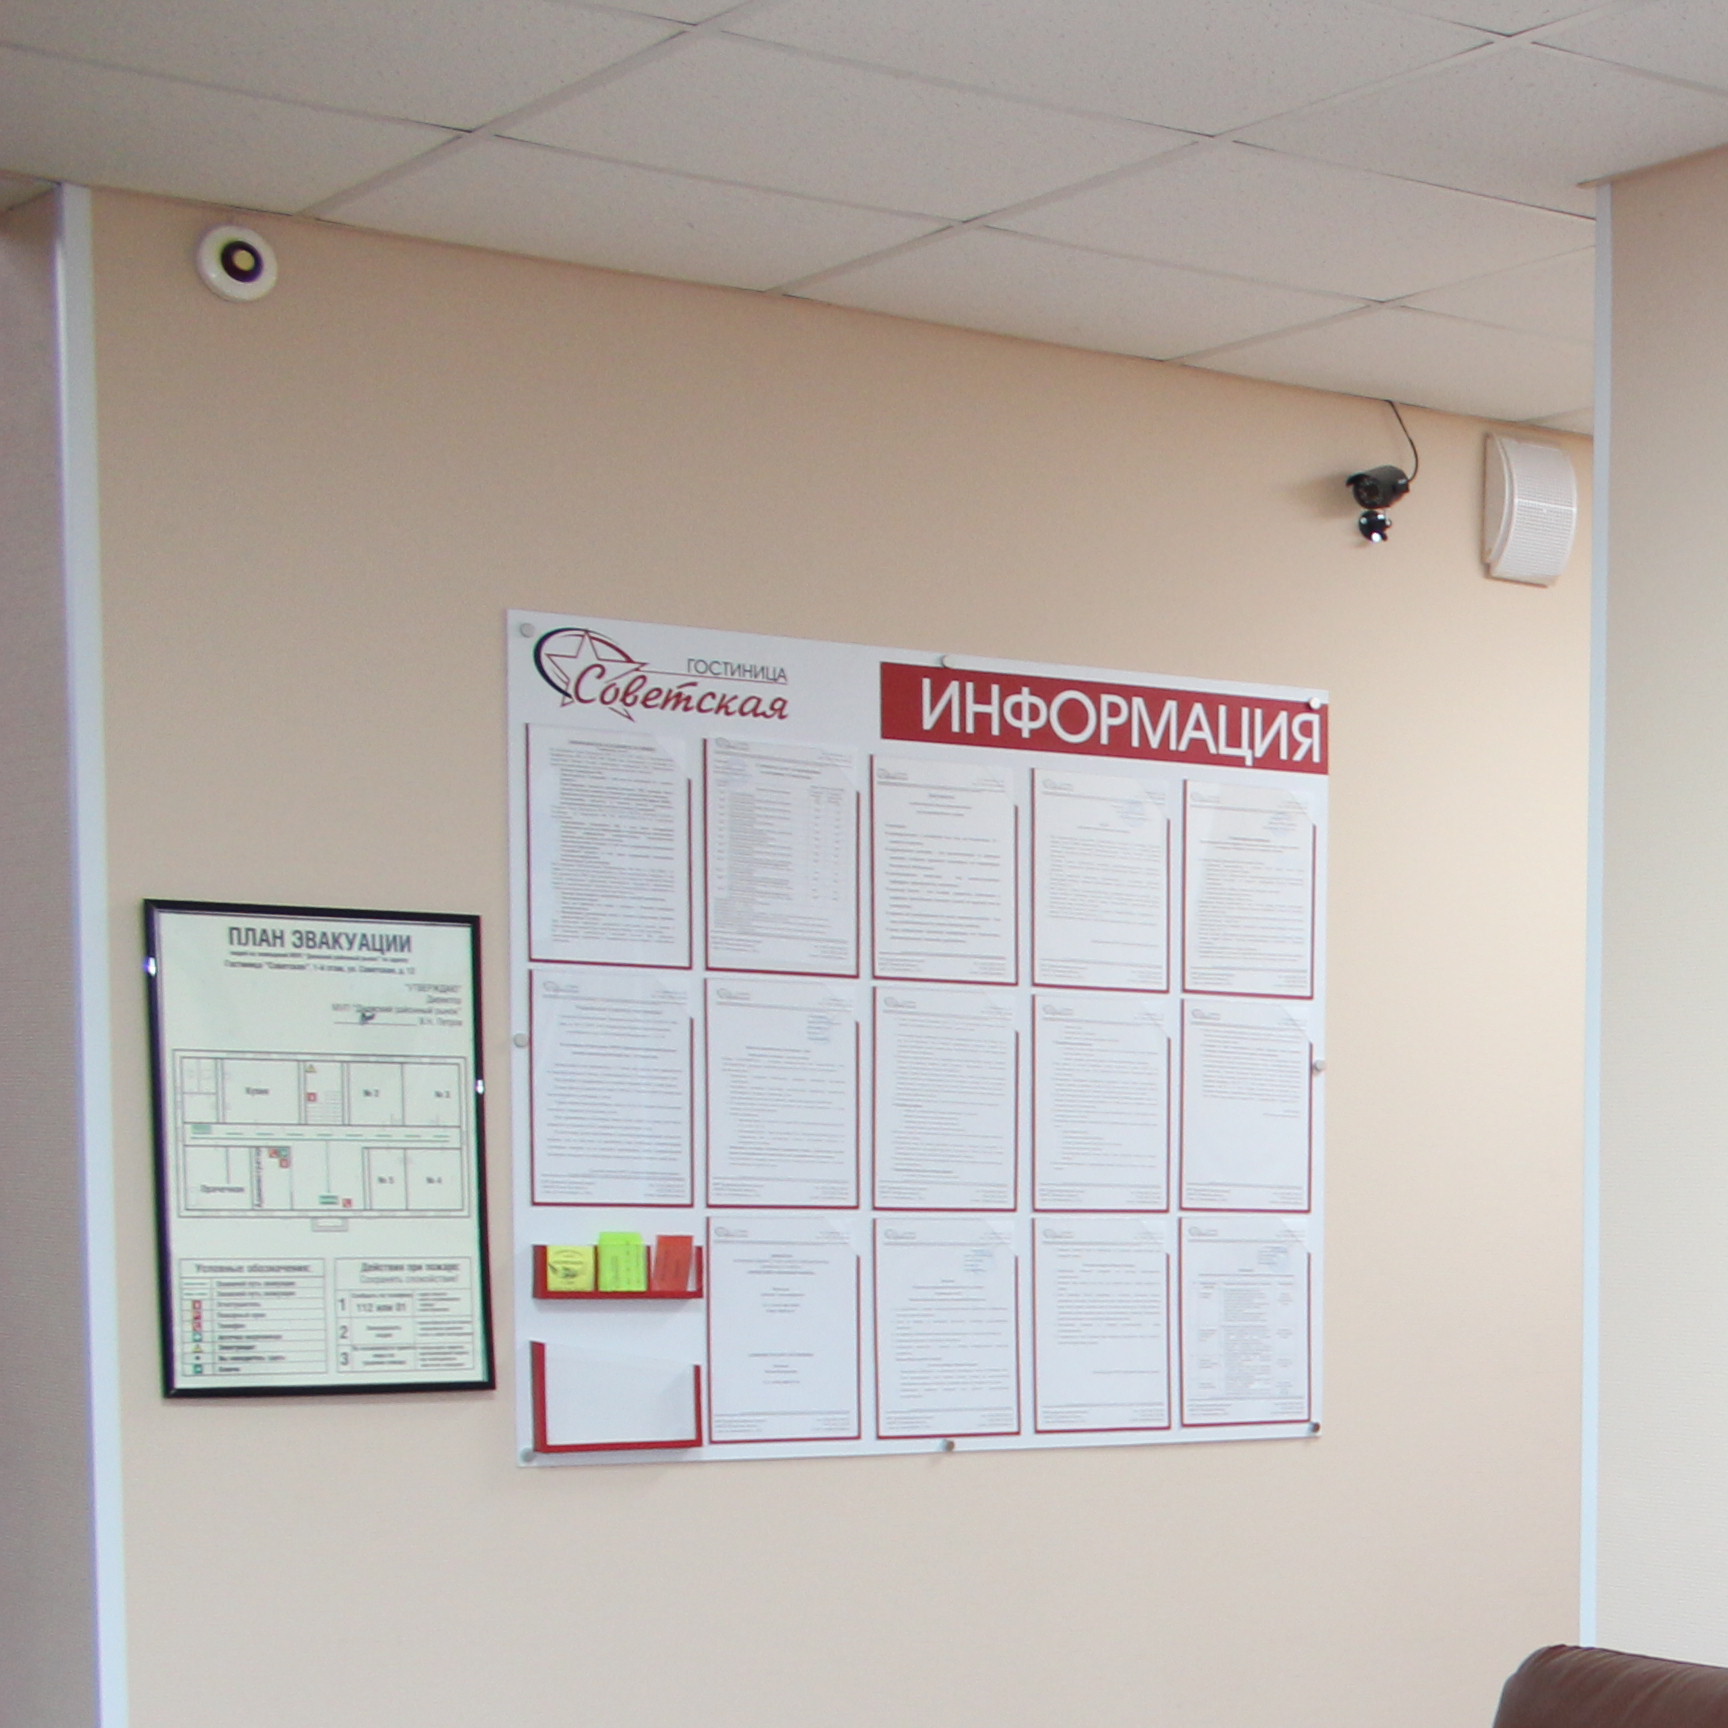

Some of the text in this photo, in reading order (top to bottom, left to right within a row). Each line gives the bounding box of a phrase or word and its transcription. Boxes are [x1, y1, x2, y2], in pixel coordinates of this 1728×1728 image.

[573, 662, 790, 720] Советская
[687, 658, 788, 682] ГОСТИНИЦА
[920, 676, 1322, 767] ИНФОРМАЦИЯ
[228, 926, 413, 955] ПЛАН ЭВАКУАЦИИ
